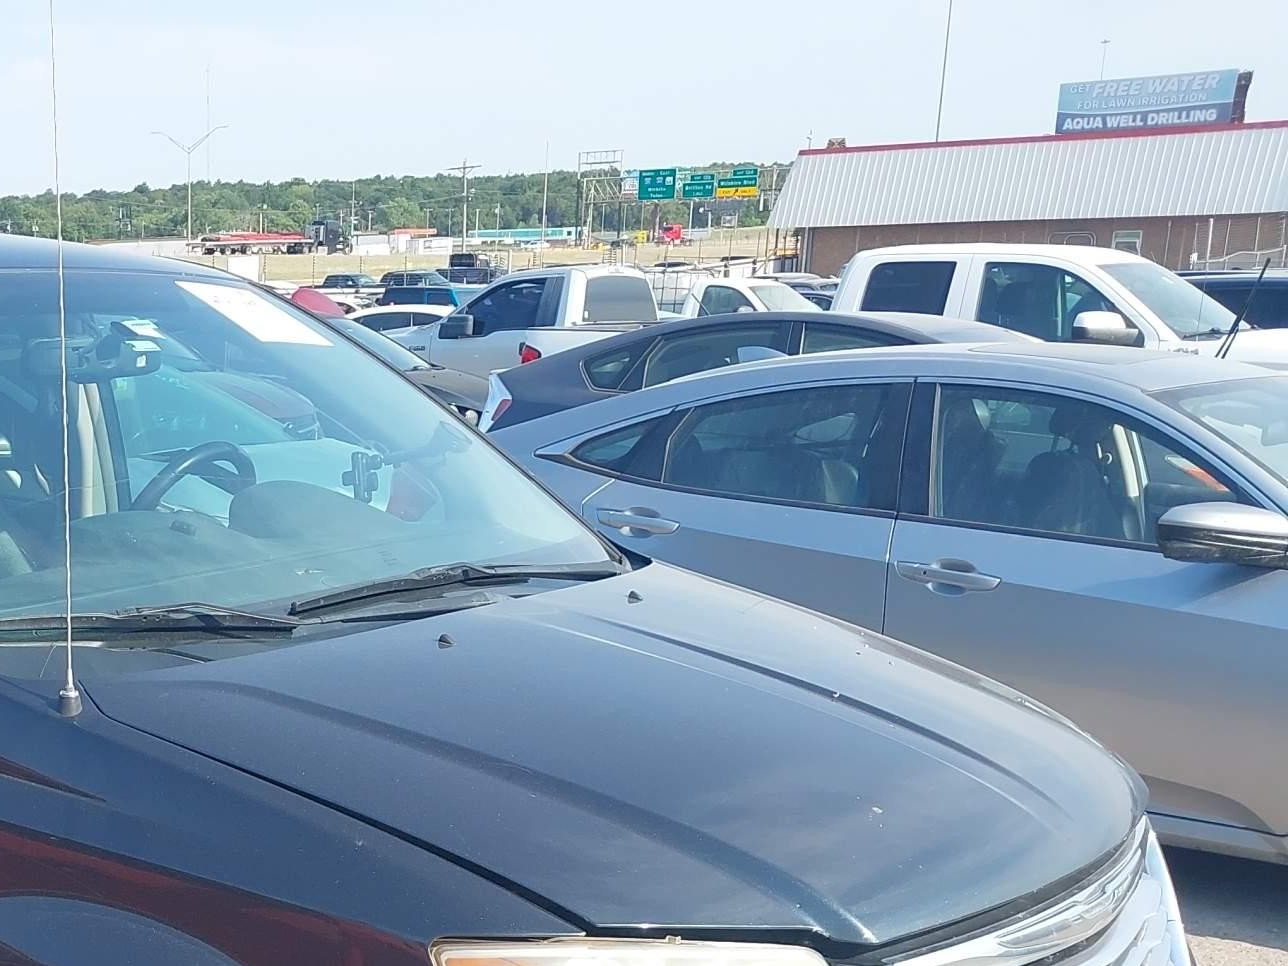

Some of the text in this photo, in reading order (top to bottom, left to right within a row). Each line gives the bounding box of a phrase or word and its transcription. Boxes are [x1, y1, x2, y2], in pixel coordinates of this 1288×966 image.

[1070, 73, 1220, 97] GET FREE WATER
[1077, 92, 1207, 110] FOR LAWN IRRIGATION
[1062, 108, 1217, 130] AQUA WELL DRILLING
